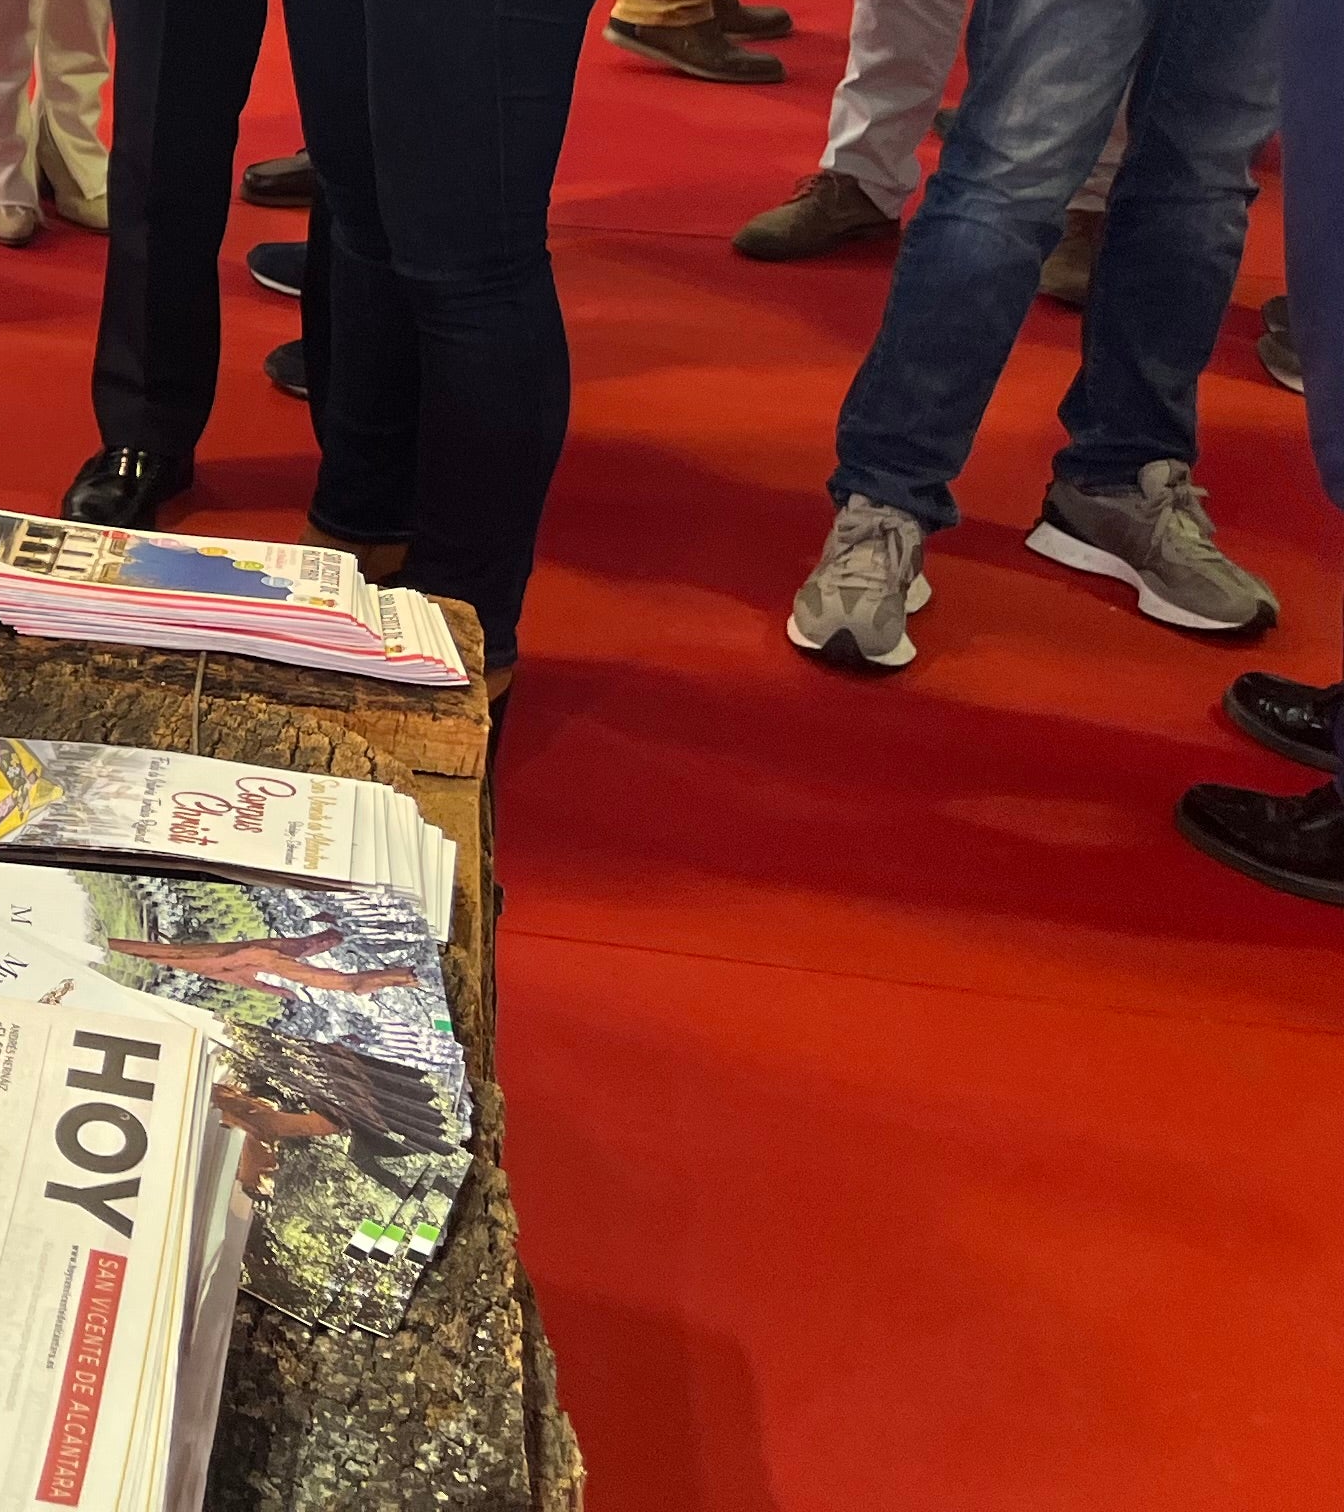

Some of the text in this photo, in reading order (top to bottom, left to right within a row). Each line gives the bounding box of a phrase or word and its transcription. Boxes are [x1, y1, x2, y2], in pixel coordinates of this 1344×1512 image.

[168, 791, 233, 846] Christi
[218, 776, 297, 833] Corpus
[44, 1029, 162, 1239] HOY
[51, 1258, 119, 1497] SAN VICENTE DE ALCÁNTARA
